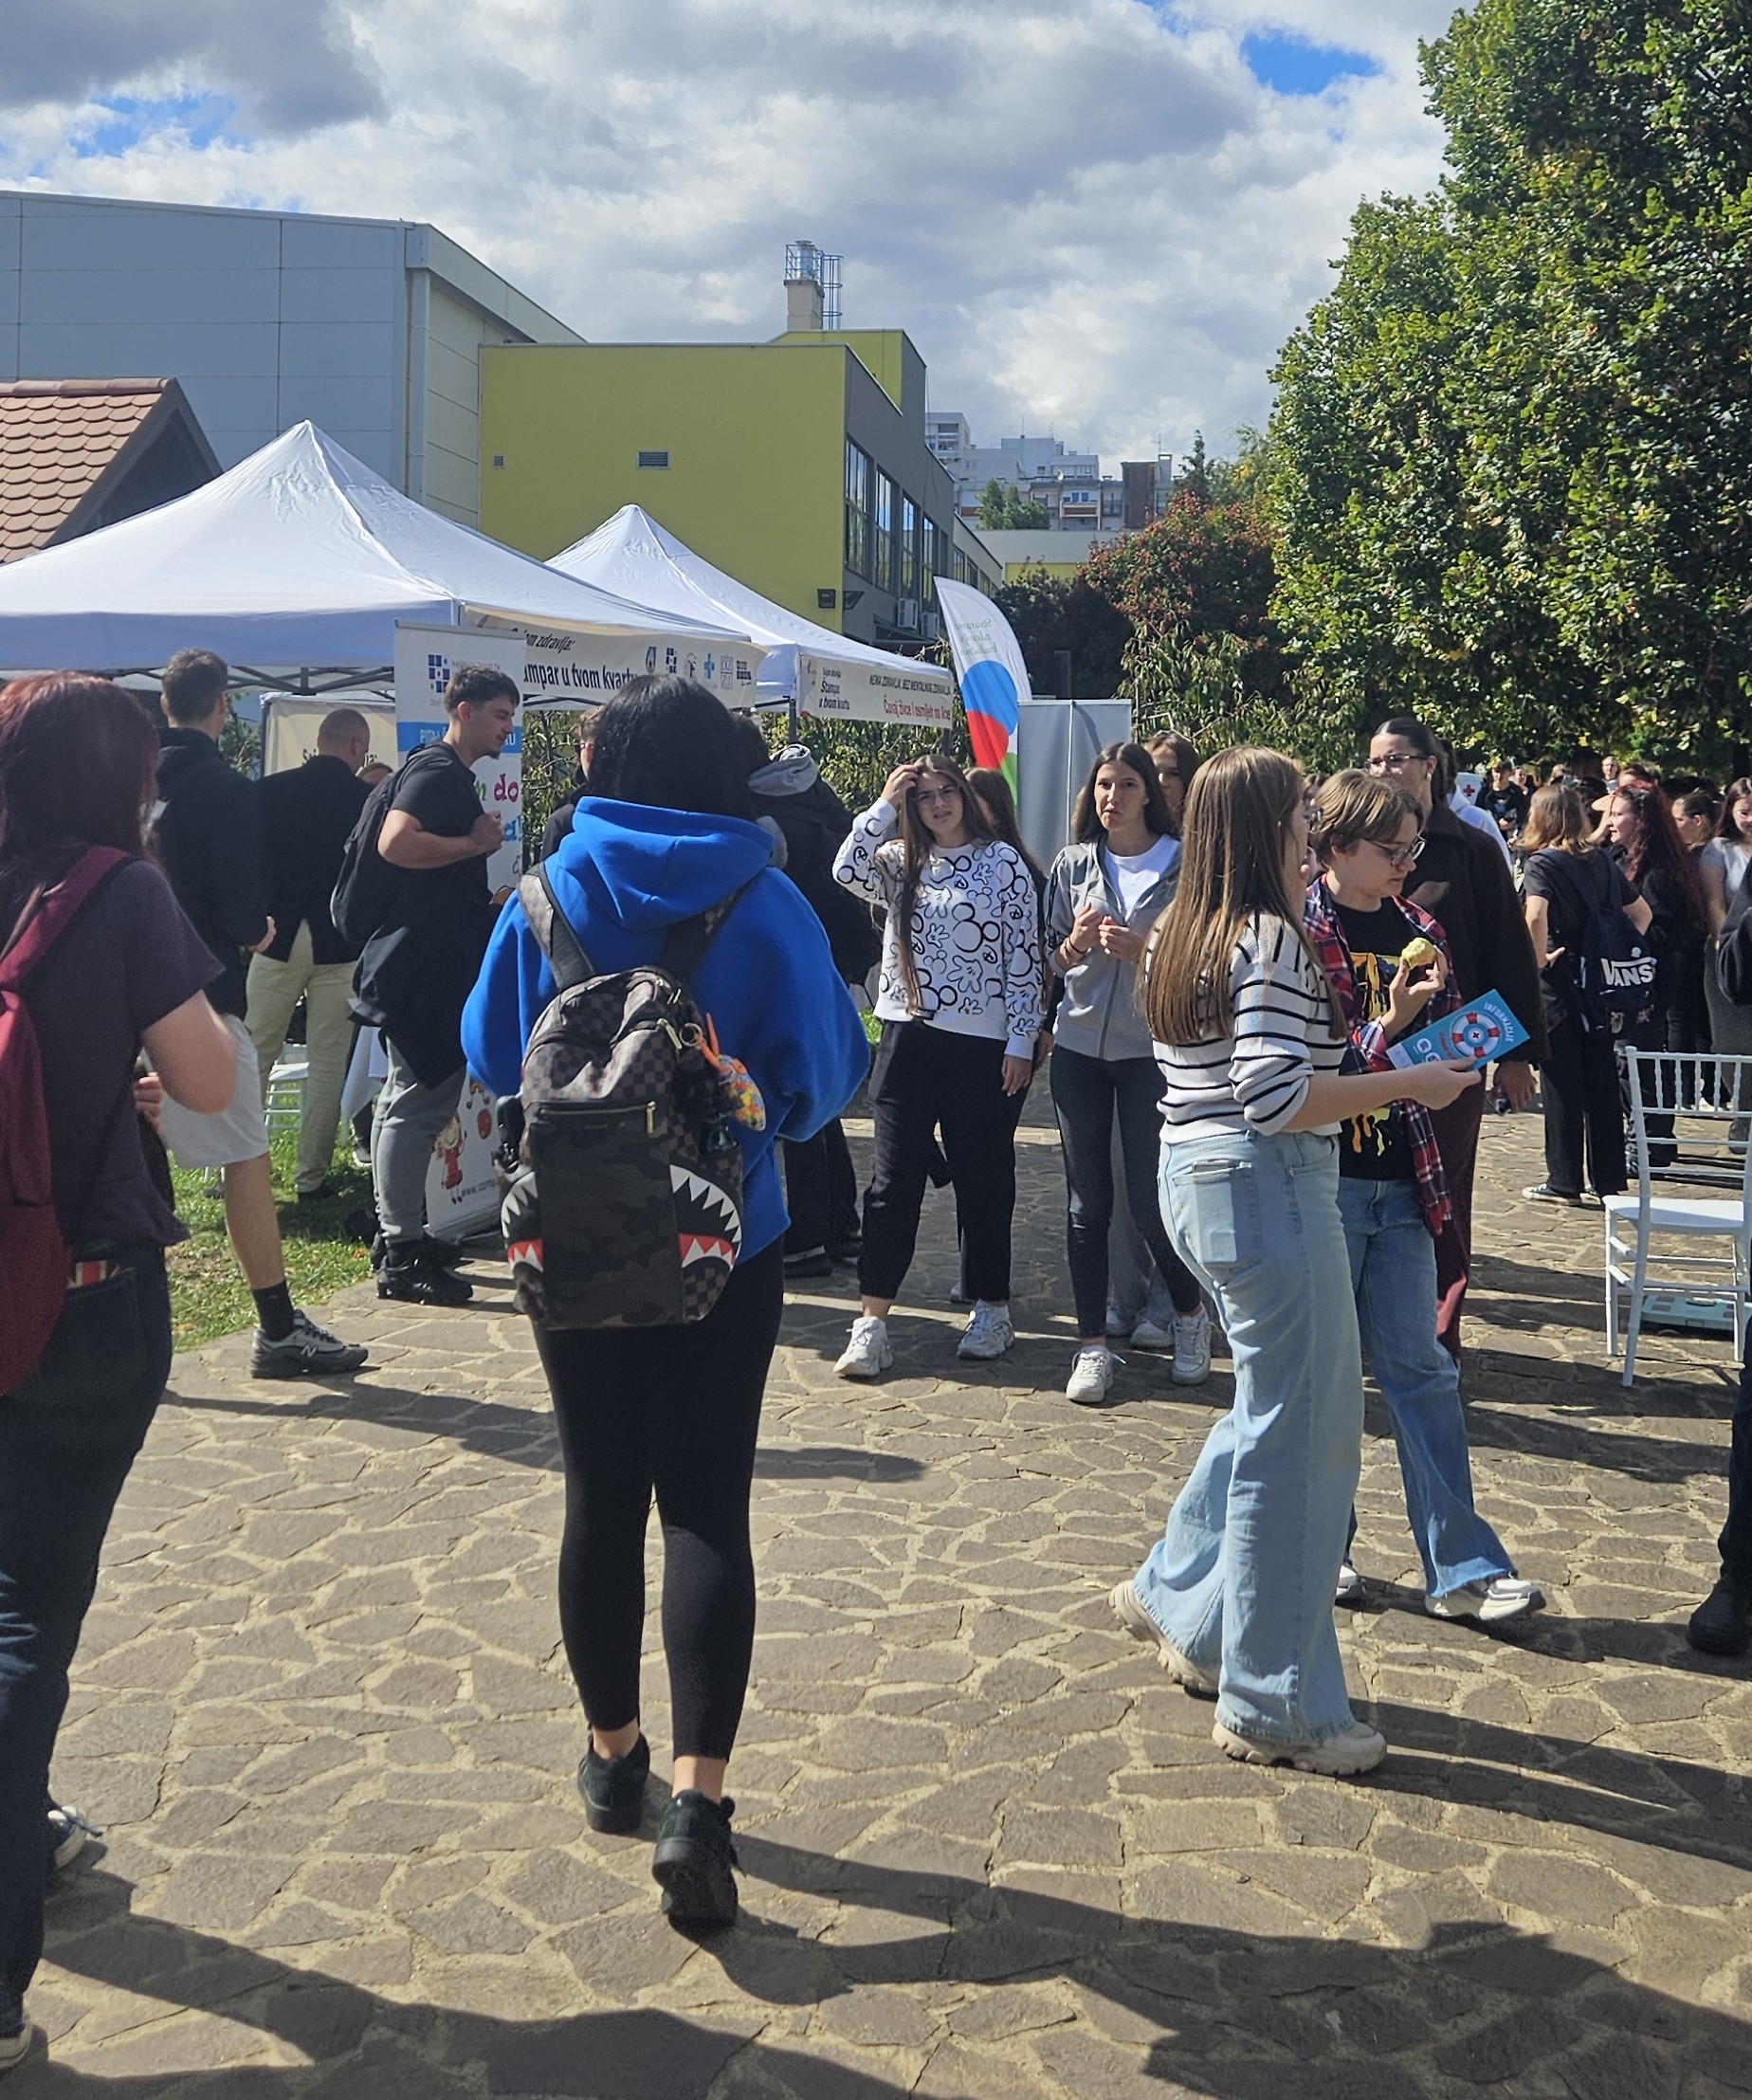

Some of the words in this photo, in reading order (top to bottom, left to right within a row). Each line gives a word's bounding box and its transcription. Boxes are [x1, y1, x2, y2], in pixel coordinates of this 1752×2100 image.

[523, 663, 558, 689] ampar
[561, 667, 571, 685] u
[572, 663, 601, 688] tvom
[602, 665, 638, 689] kvart
[494, 773, 520, 803] do
[1600, 956, 1657, 987] VANS
